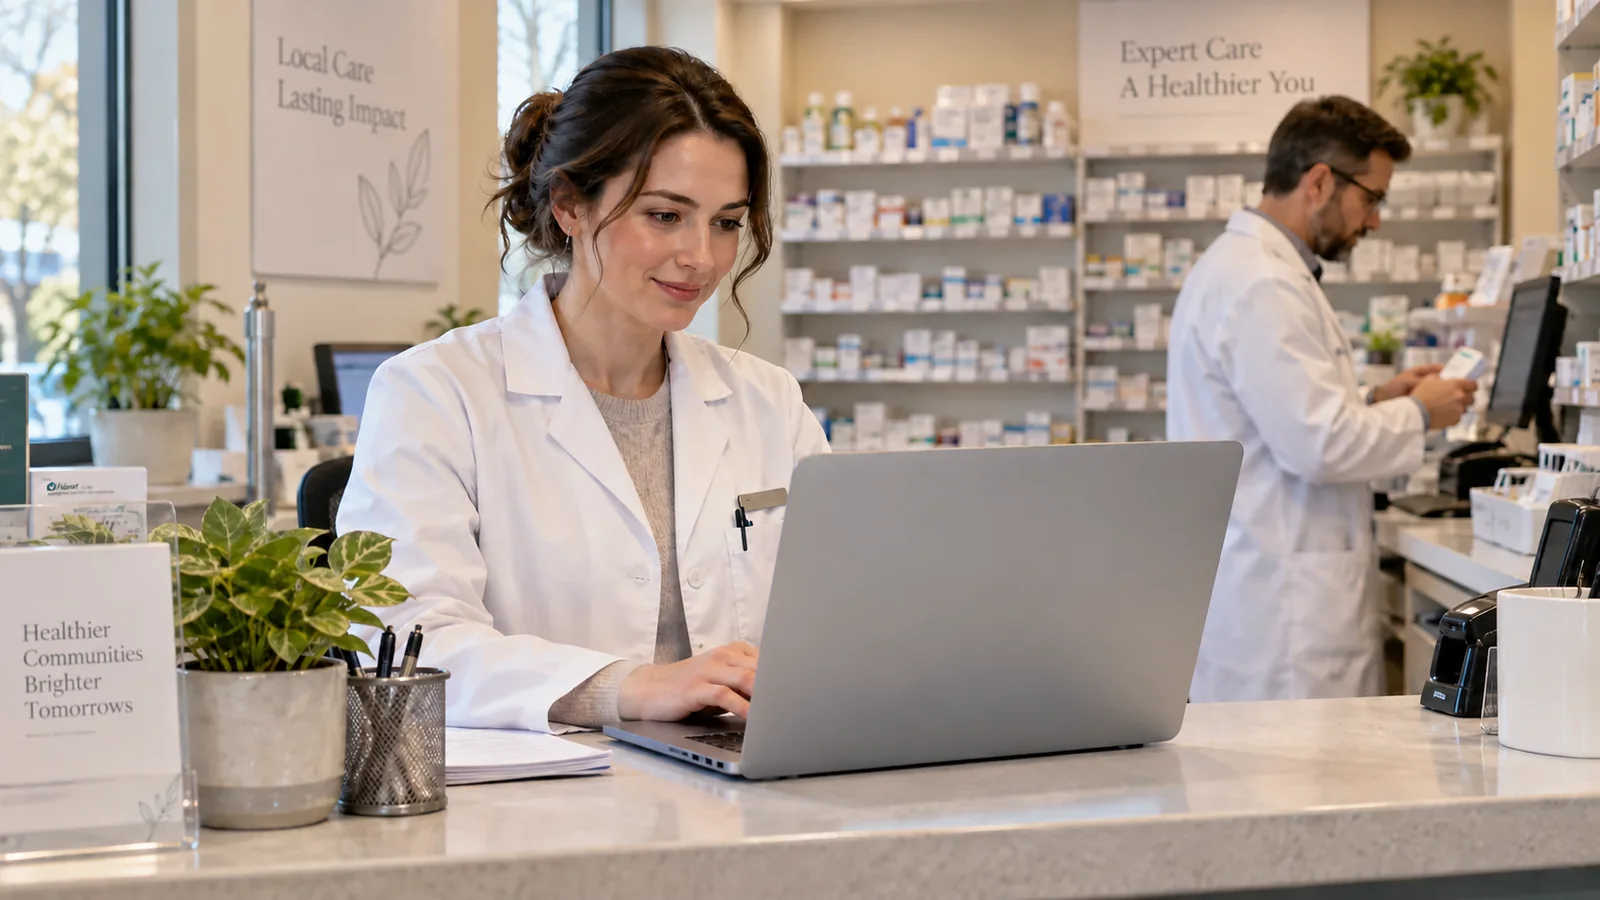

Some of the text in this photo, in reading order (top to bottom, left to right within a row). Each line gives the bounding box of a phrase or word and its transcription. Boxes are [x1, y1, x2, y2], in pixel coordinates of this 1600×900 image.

[278, 36, 375, 84] Local Care
[1119, 36, 1263, 69] Expert Care
[1119, 70, 1315, 99] A Healthier You
[277, 79, 407, 134] Lasting Impact
[22, 620, 111, 642] Healthier
[23, 645, 144, 668] Communities
[24, 673, 102, 698] Brighter
[24, 700, 134, 720] Tomorrows
